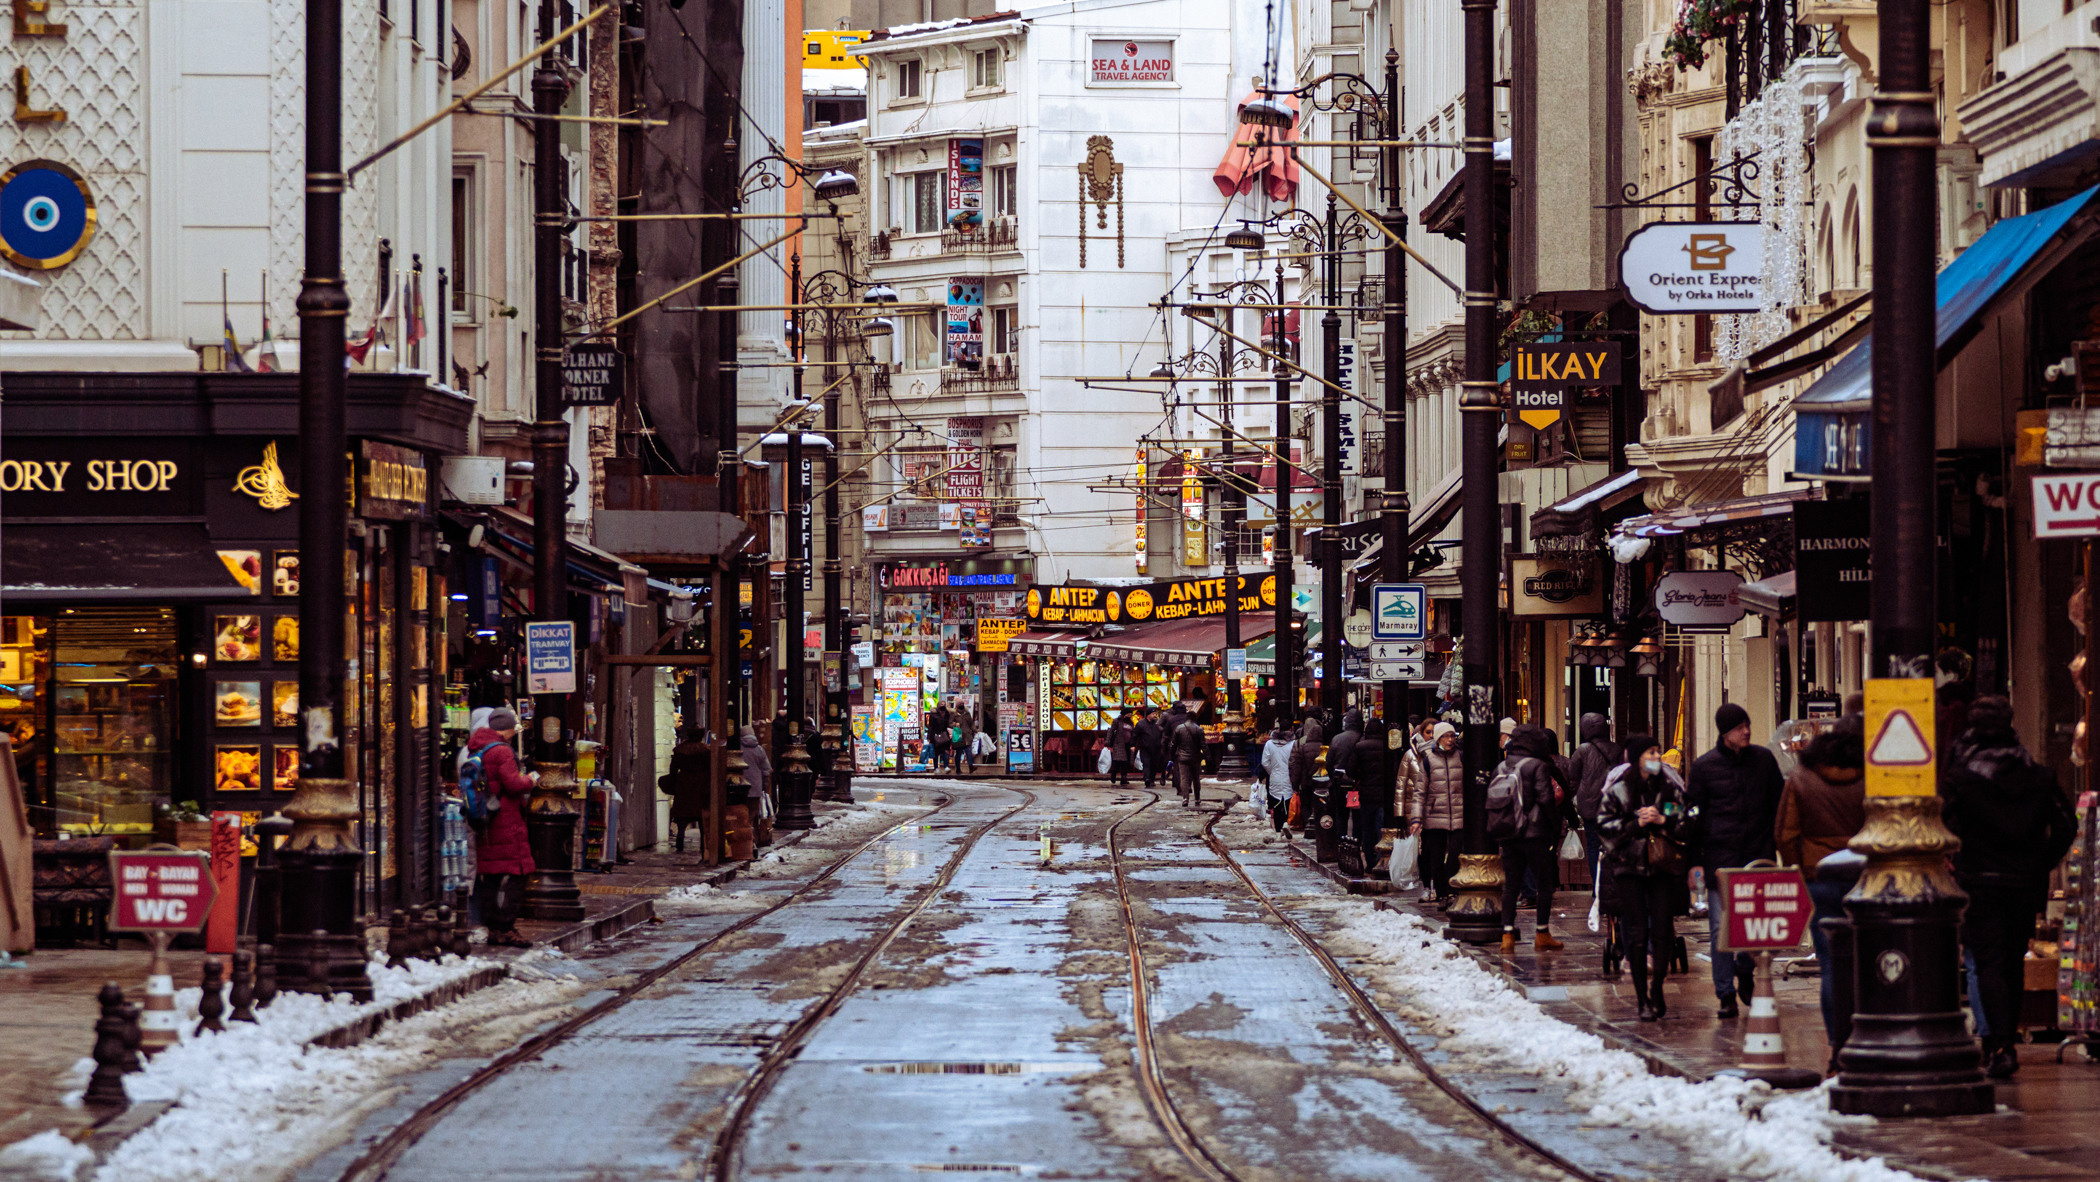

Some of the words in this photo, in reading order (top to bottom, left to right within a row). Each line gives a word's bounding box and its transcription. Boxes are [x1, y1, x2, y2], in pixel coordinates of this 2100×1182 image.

[1092, 59, 1117, 71] SEA
[1120, 59, 1130, 71] &
[1133, 59, 1171, 71] LAND
[1095, 72, 1130, 80] TRAVEL
[1131, 72, 1168, 80] AGENCY
[950, 140, 959, 209] ISLANDS
[1649, 273, 1704, 286] Orient
[1668, 290, 1682, 302] by
[1685, 290, 1713, 300] Orka
[1717, 289, 1754, 299] Hotels
[948, 305, 969, 314] NIGHT
[949, 313, 967, 321] TOUR
[1517, 347, 1608, 380] İLKAY
[562, 369, 609, 384] ORNER
[1516, 390, 1563, 406] Hotel
[948, 418, 983, 429] BOSPHORUS
[86, 459, 178, 492] SHOP
[950, 475, 980, 486] FLIGHT
[948, 486, 983, 497] TICKETS
[1533, 582, 1552, 590] RED
[1049, 587, 1097, 607] ANTEP
[1662, 589, 1696, 607] Gloria
[1693, 588, 1727, 607] Jeans
[980, 620, 1025, 628] ANTEP
[1379, 621, 1419, 631] Marmaray
[531, 627, 570, 639] DİKKAT
[530, 640, 570, 648] TRAMVAY
[123, 865, 148, 880] BAY
[159, 865, 199, 881] BAYAN
[1733, 883, 1756, 898] BAY
[1763, 882, 1799, 898] BAYAN
[134, 899, 188, 923] WC
[1743, 916, 1789, 941] WC
